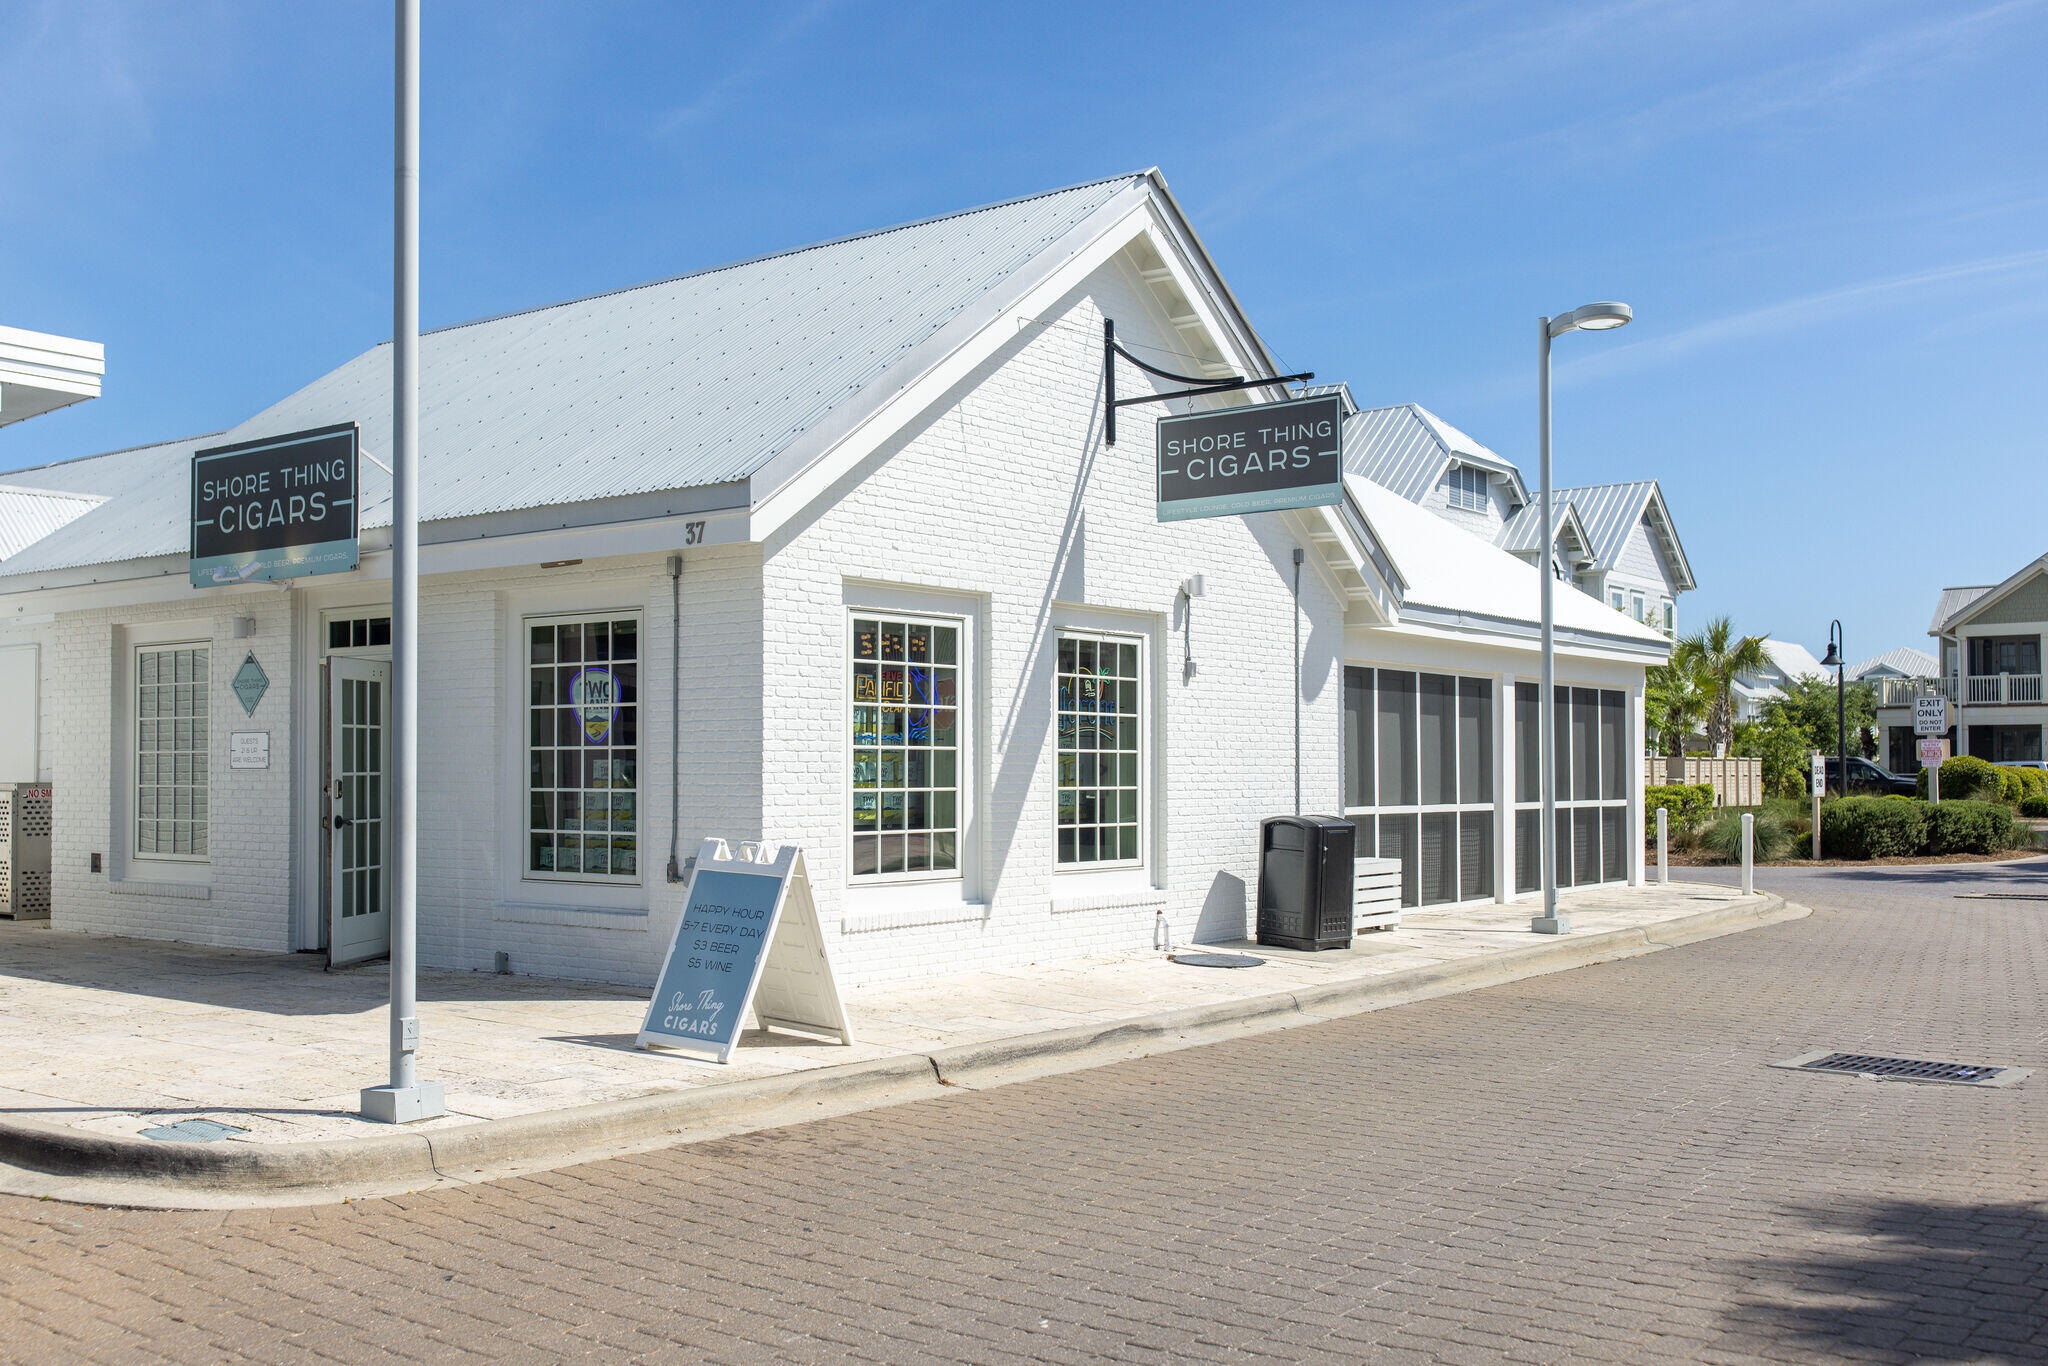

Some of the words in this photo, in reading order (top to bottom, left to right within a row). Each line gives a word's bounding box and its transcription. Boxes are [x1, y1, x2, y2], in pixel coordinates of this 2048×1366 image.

[1167, 432, 1246, 456] SHORE
[1258, 420, 1331, 445] THING
[1186, 446, 1311, 480] CIGARS
[203, 472, 270, 502] SHORE
[280, 459, 345, 489] THING
[219, 491, 327, 534] CIGARS
[686, 520, 706, 545] 37
[856, 675, 912, 699] PAIFICO
[1919, 699, 1941, 707] EXIT
[1918, 709, 1943, 717] ONLY
[1814, 765, 1824, 775] DEAD
[1815, 778, 1823, 788] END
[28, 789, 40, 798] NO
[693, 903, 729, 916] HAPPY
[732, 907, 765, 920] HOUR
[682, 920, 699, 931] 5-7
[701, 922, 737, 936] EVERY
[739, 927, 765, 939] DAY
[693, 939, 707, 951] $3
[710, 942, 739, 955] BEER
[688, 957, 702, 969] $5
[704, 960, 733, 973] WINE
[669, 991, 692, 1012] Shore
[697, 989, 724, 1021] Thing
[664, 1015, 718, 1036] CIGARS
